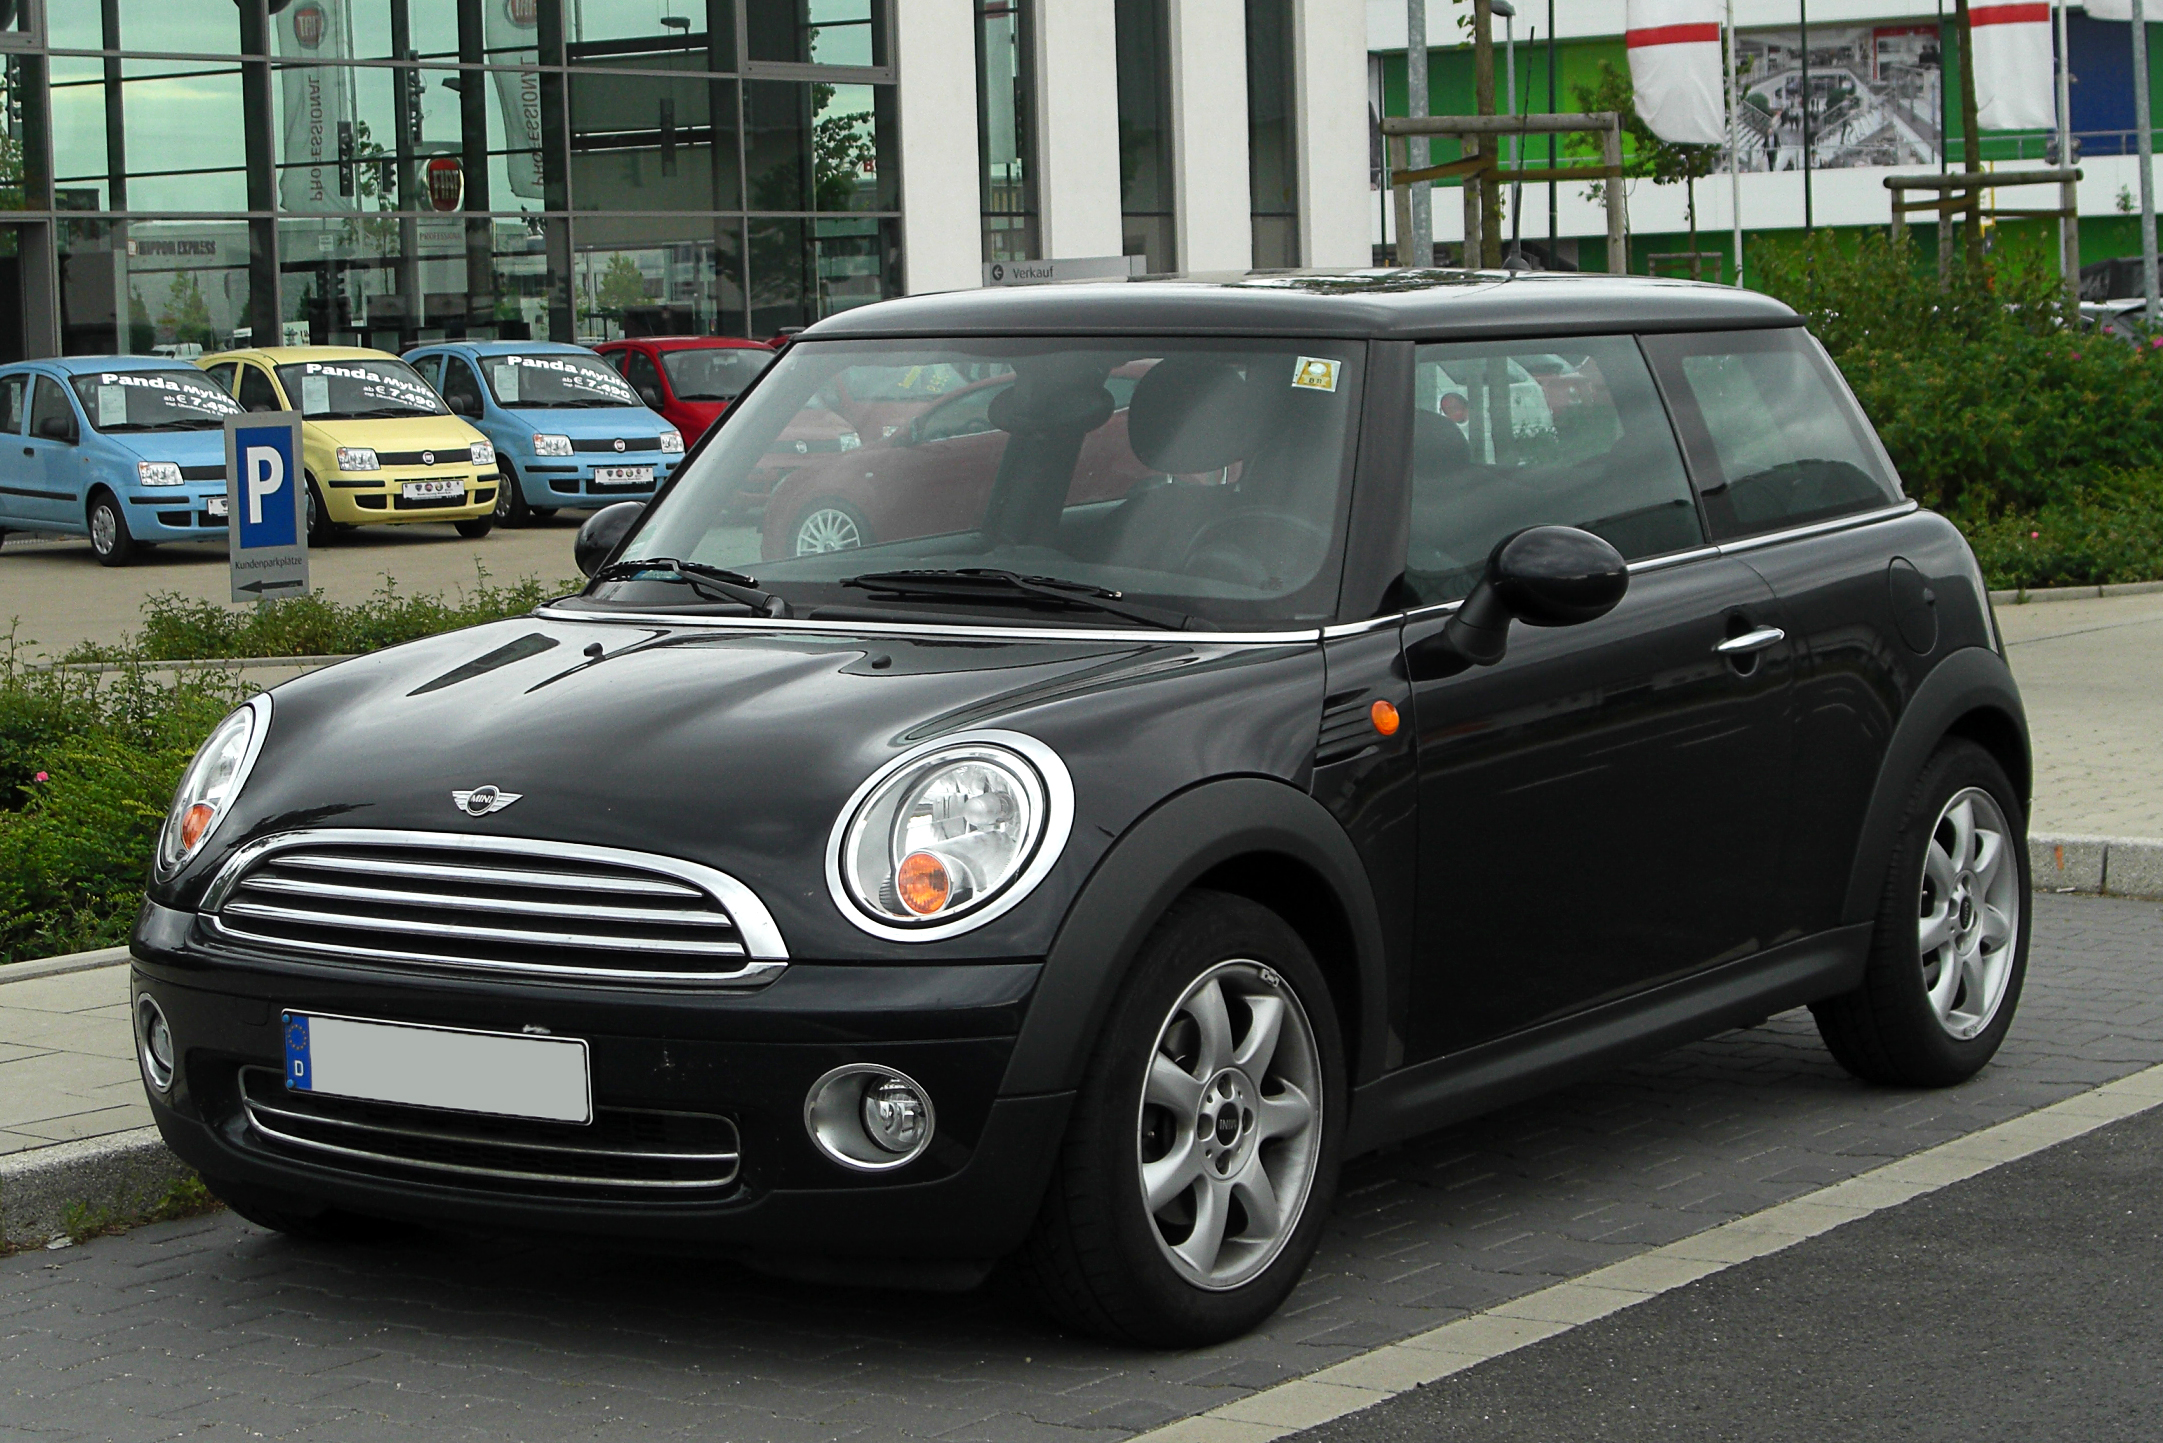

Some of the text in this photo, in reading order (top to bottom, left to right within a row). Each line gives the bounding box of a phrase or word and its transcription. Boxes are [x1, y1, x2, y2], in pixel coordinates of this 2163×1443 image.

[432, 169, 459, 199] FIAT
[1012, 265, 1054, 279] Verkauf
[306, 363, 435, 398] Panda MyLife
[507, 355, 629, 389] Panda MyLife
[101, 373, 237, 406] Panda MyLife
[176, 394, 188, 404] €
[375, 384, 386, 395] €
[389, 387, 437, 409] 7.490
[573, 376, 584, 386] €
[586, 379, 631, 399] 7.490
[246, 445, 284, 524] P
[234, 555, 303, 570] Kundenparkplätze
[470, 794, 494, 803] MINI
[294, 1060, 305, 1077] D
[1219, 1118, 1238, 1130] MINI
